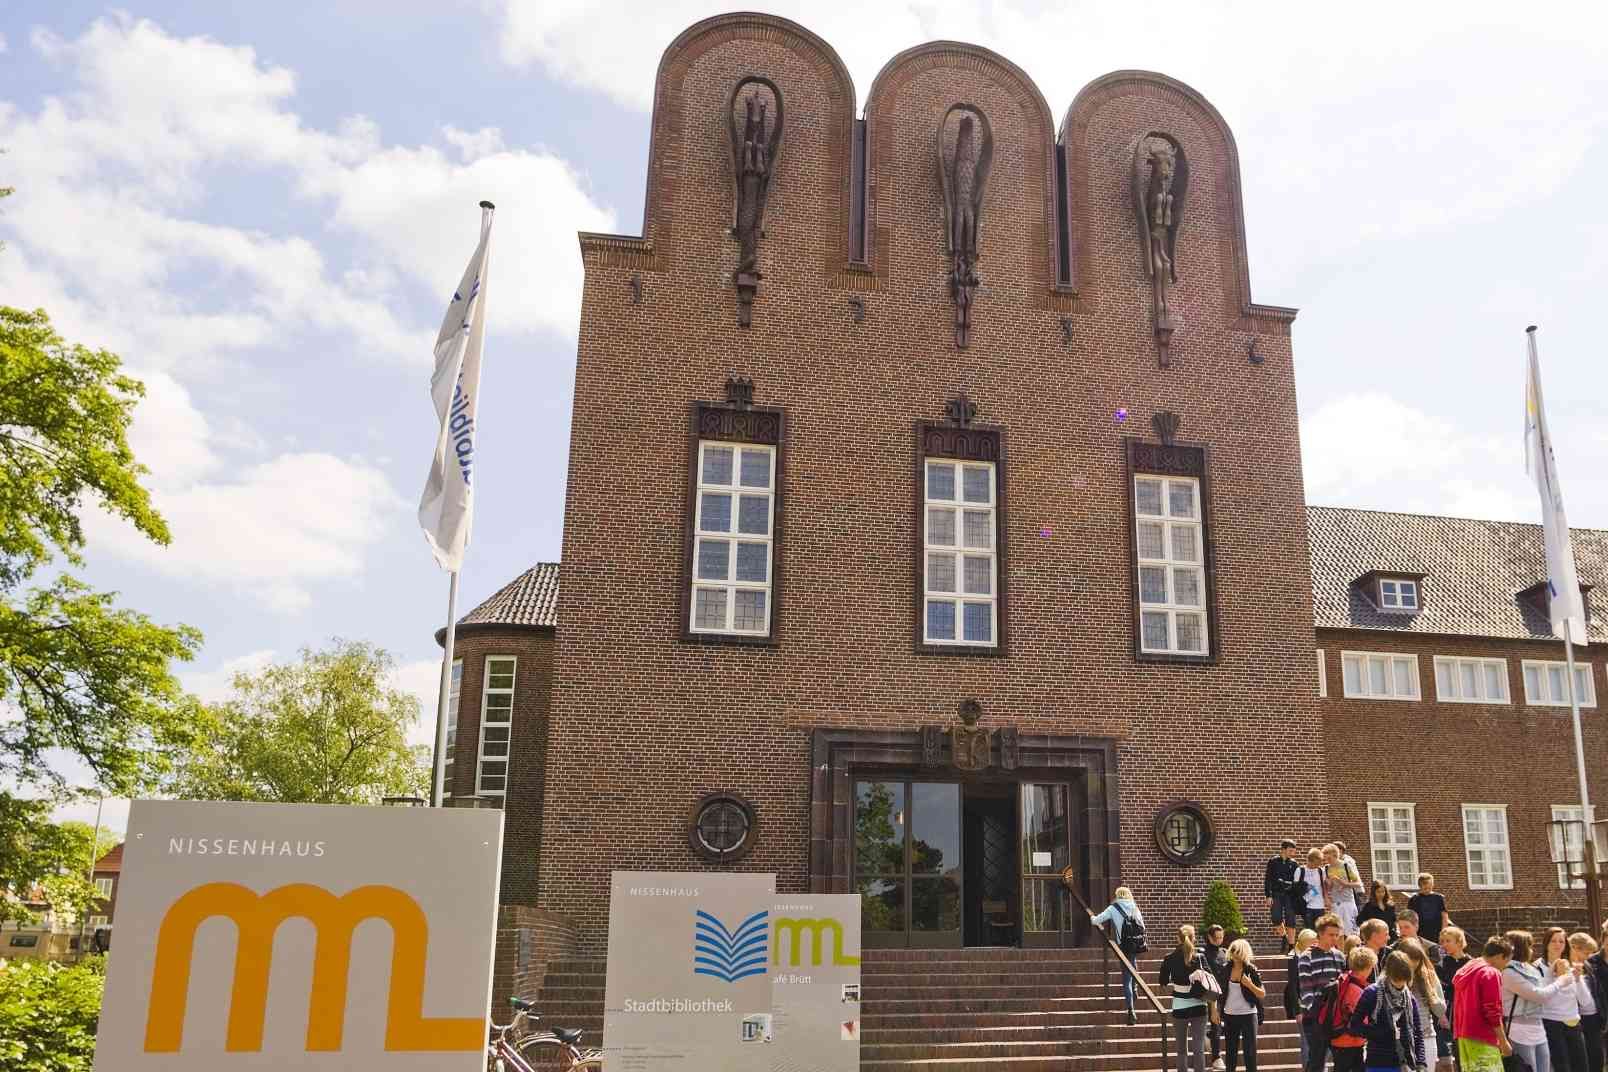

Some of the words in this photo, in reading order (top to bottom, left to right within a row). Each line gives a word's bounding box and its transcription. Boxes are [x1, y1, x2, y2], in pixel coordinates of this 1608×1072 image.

[168, 837, 327, 858] NISSENHAUS
[629, 887, 700, 897] NISSENHAUS
[773, 974, 788, 984] afé
[623, 998, 733, 1013] Stadtbibliothek
